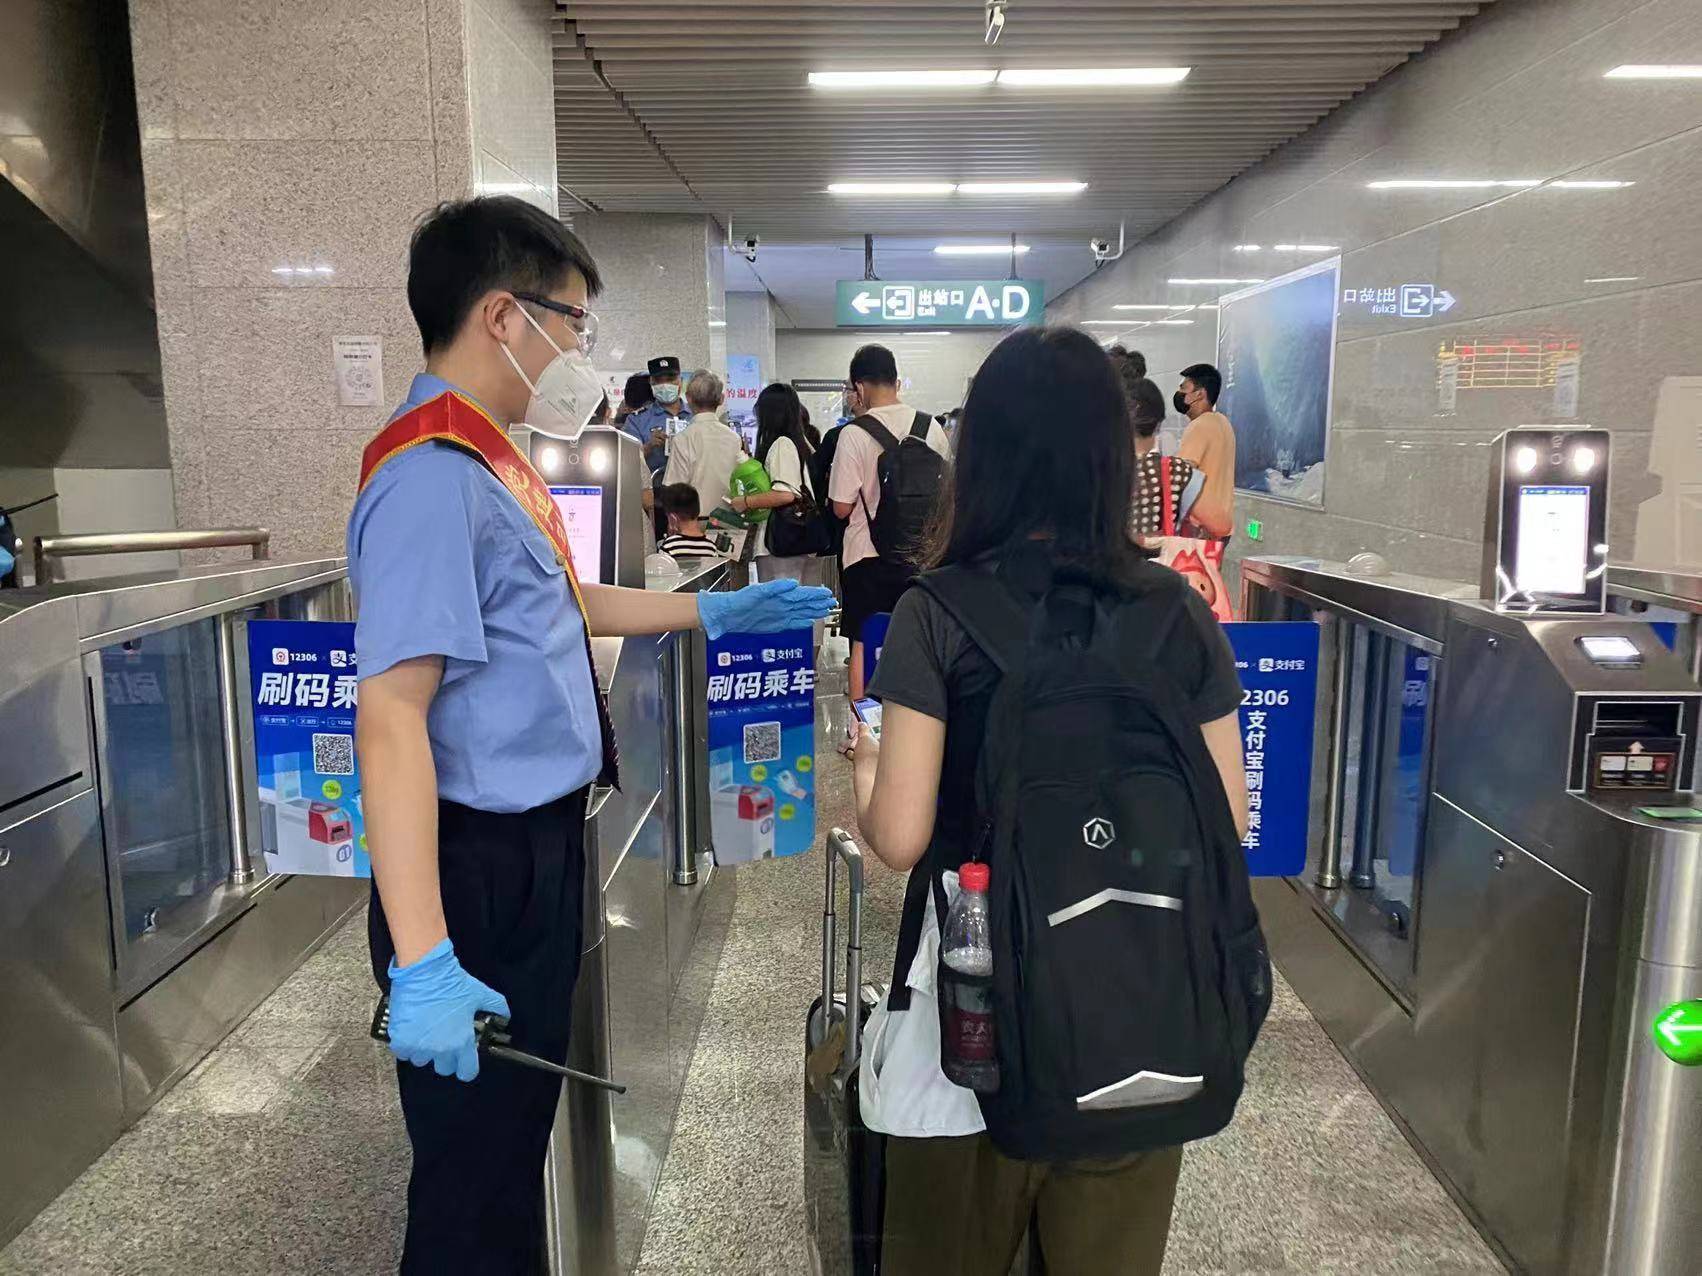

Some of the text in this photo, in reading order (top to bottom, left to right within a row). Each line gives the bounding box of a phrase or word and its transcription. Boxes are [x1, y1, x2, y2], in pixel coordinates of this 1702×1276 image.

[918, 288, 964, 306] 出站口
[289, 653, 318, 662] 12306
[731, 648, 803, 662] 12306 支付宝
[1274, 660, 1305, 671] 支付宝
[707, 667, 815, 702] 刷码乘车
